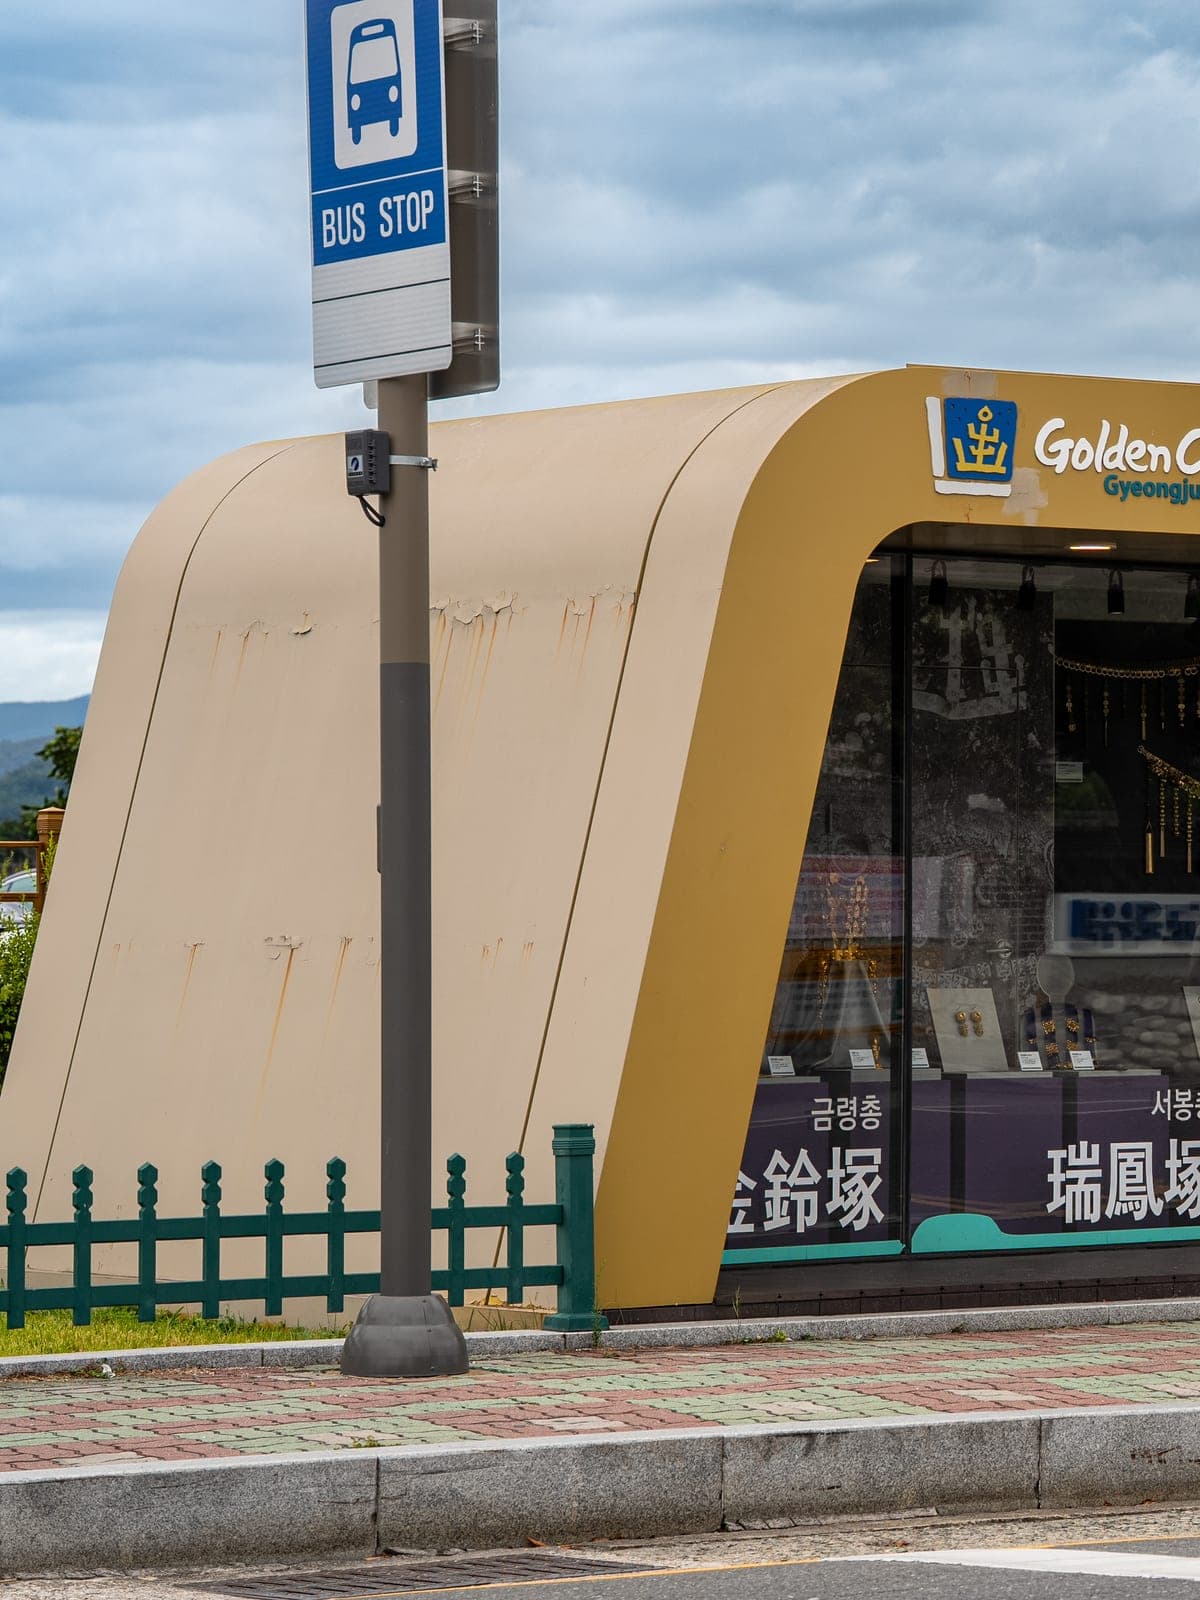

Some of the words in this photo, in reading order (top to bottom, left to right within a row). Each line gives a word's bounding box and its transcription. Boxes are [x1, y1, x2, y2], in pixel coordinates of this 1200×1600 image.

[322, 202, 366, 248] BUS
[379, 189, 435, 238] STOP
[1034, 417, 1171, 474] Golden
[811, 1095, 882, 1131] 금령총
